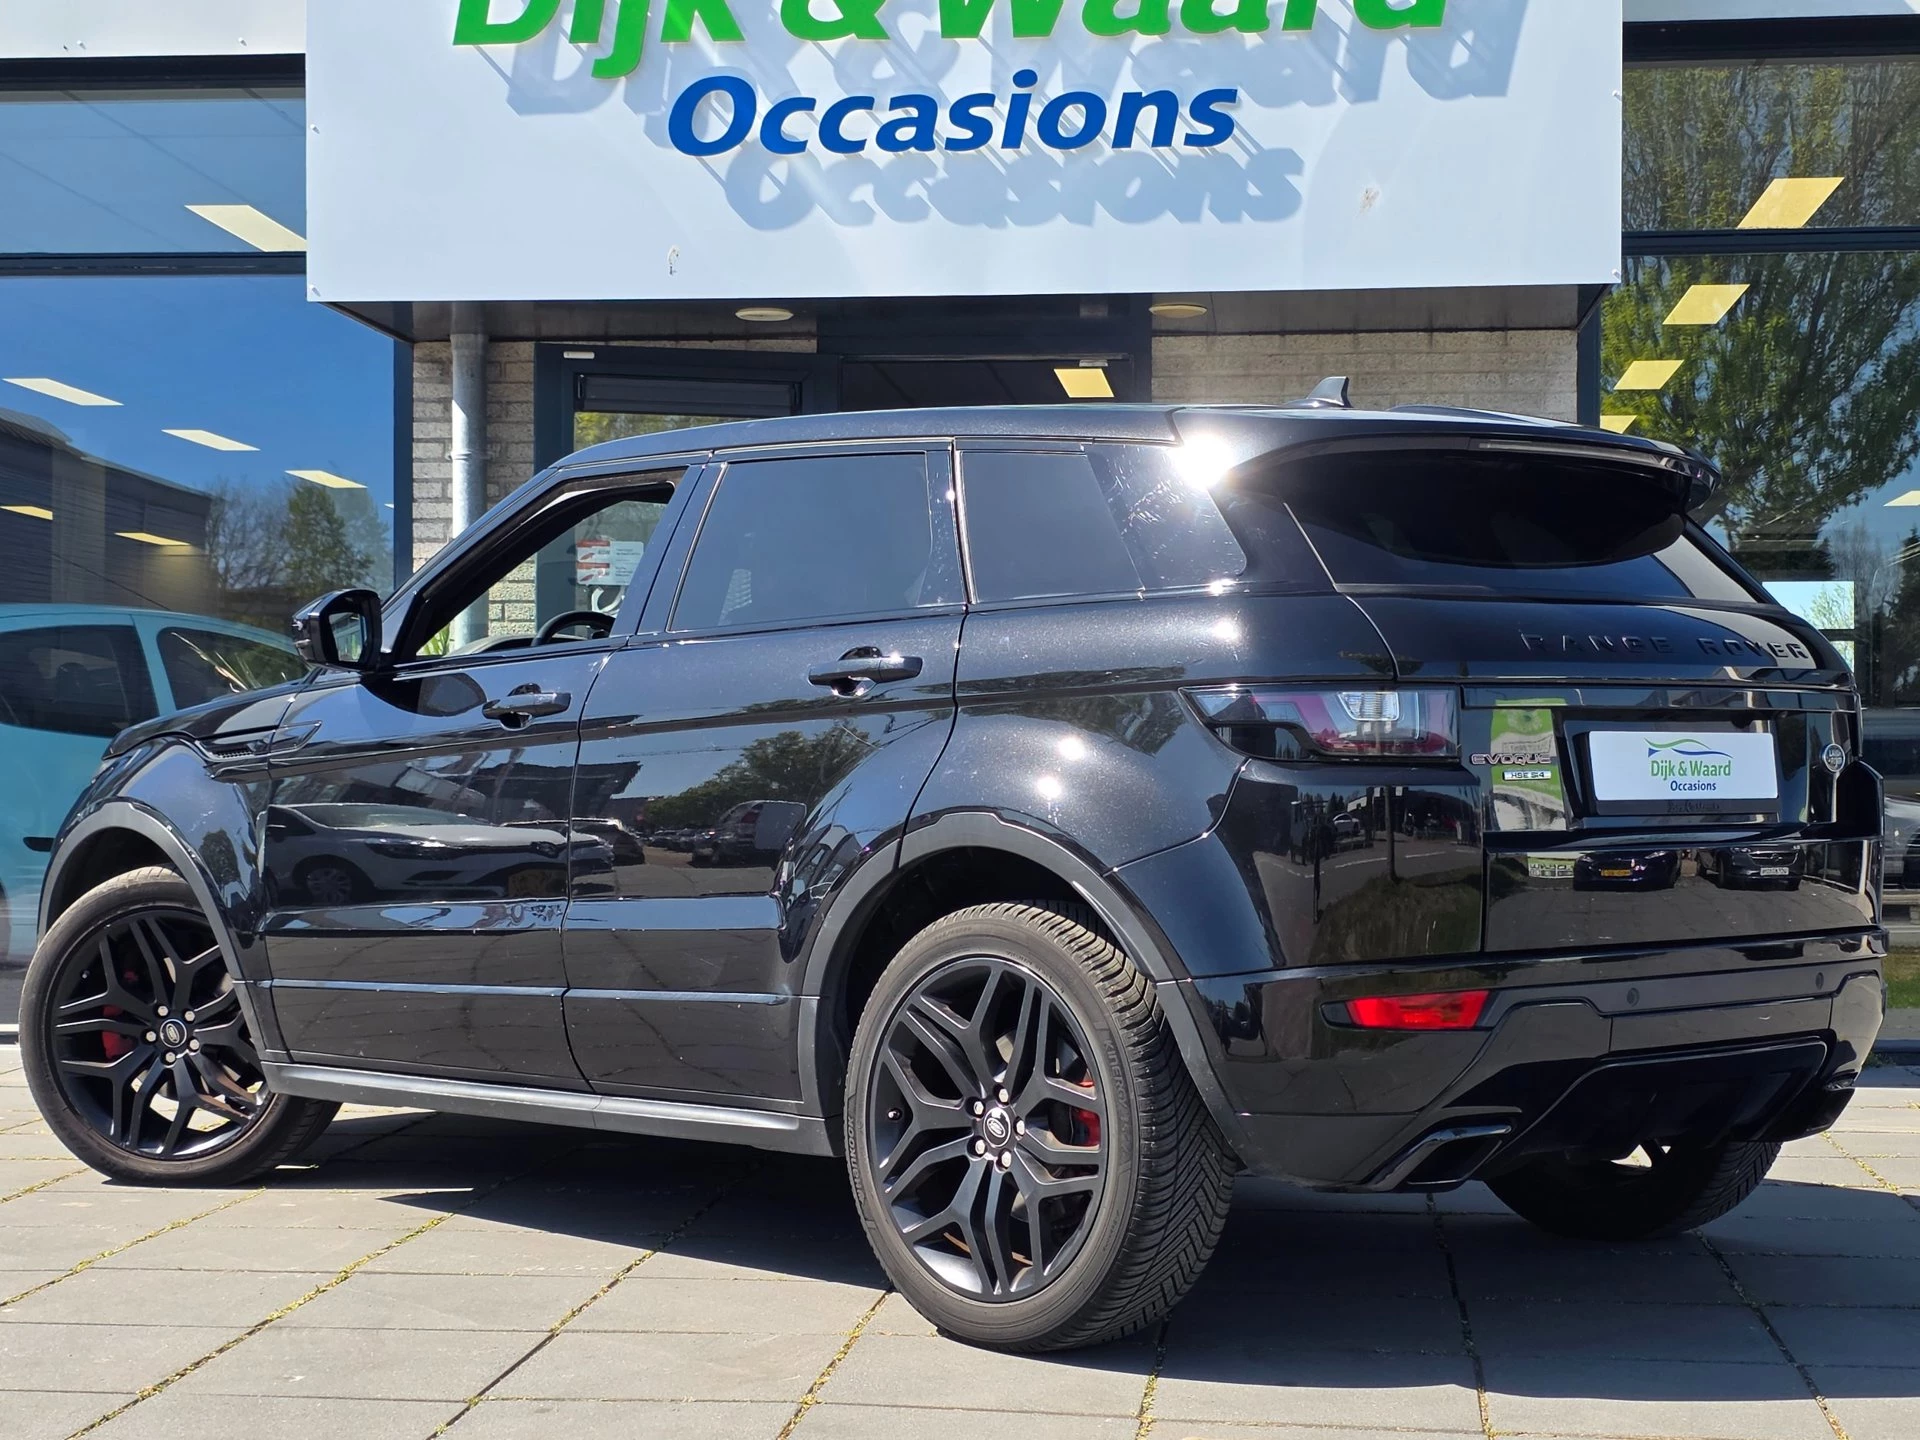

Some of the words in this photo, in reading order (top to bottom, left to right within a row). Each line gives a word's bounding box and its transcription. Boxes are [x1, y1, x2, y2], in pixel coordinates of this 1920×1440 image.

[668, 69, 1238, 156] Occasions
[1519, 632, 1673, 655] RANGE
[1698, 637, 1809, 660] ROVER
[1470, 752, 1552, 766] EVOQUE
[1511, 771, 1529, 779] HSE
[1651, 760, 1676, 781] Dijk
[1678, 760, 1687, 777] &
[1689, 760, 1732, 777] Waard
[1670, 780, 1717, 792] Occasions
